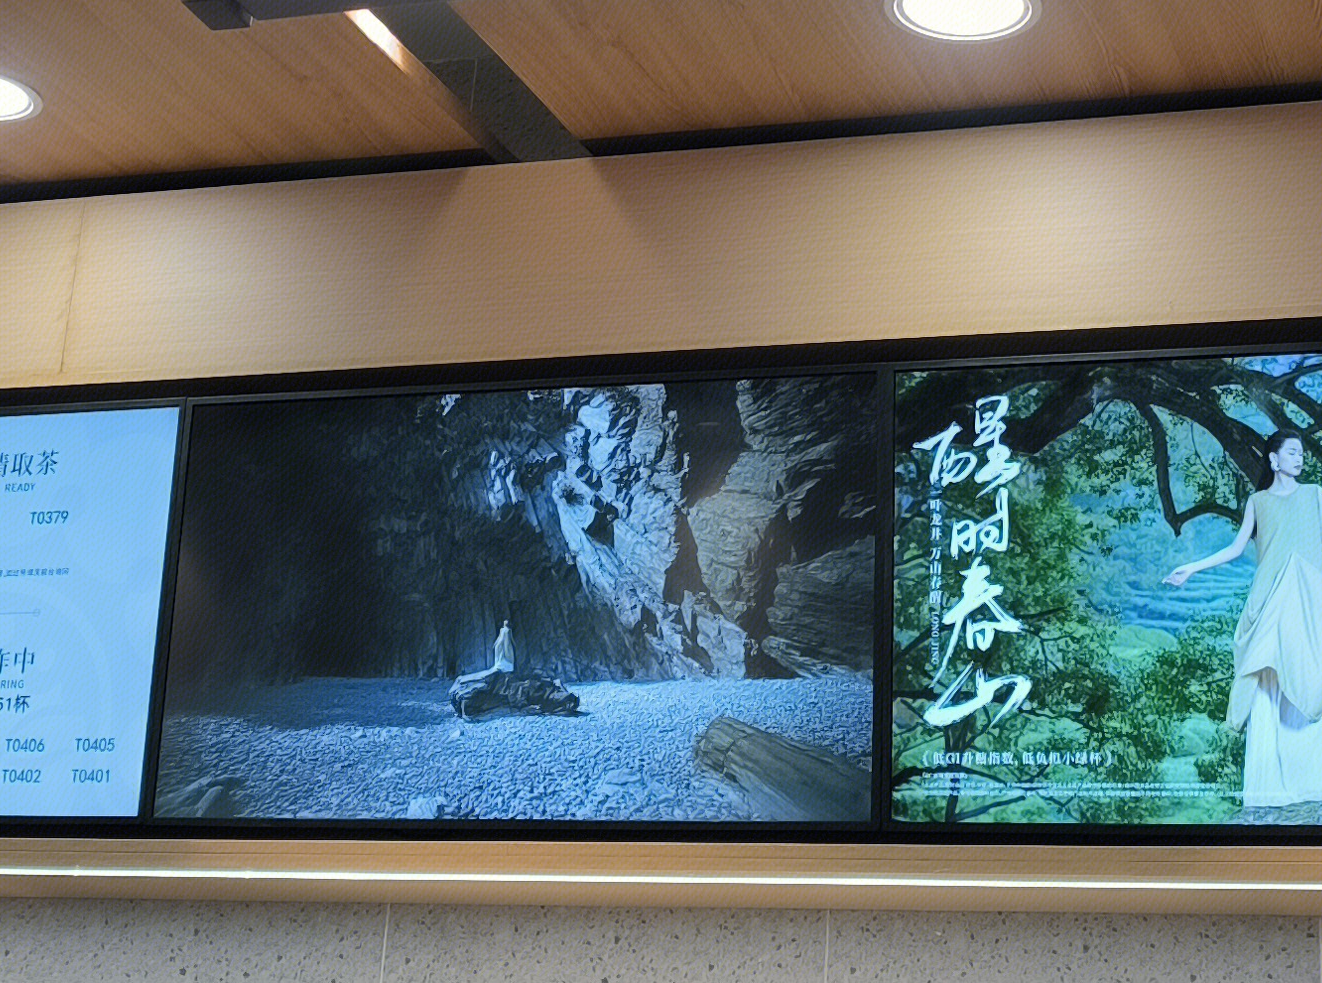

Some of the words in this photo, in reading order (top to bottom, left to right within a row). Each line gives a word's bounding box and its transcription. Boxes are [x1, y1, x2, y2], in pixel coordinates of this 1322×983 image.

[4, 482, 37, 493] READY
[29, 510, 69, 526] T0379
[5, 738, 45, 753] T0406
[75, 737, 116, 753] T0405
[2, 768, 42, 784] T0402
[71, 768, 111, 784] T0401
